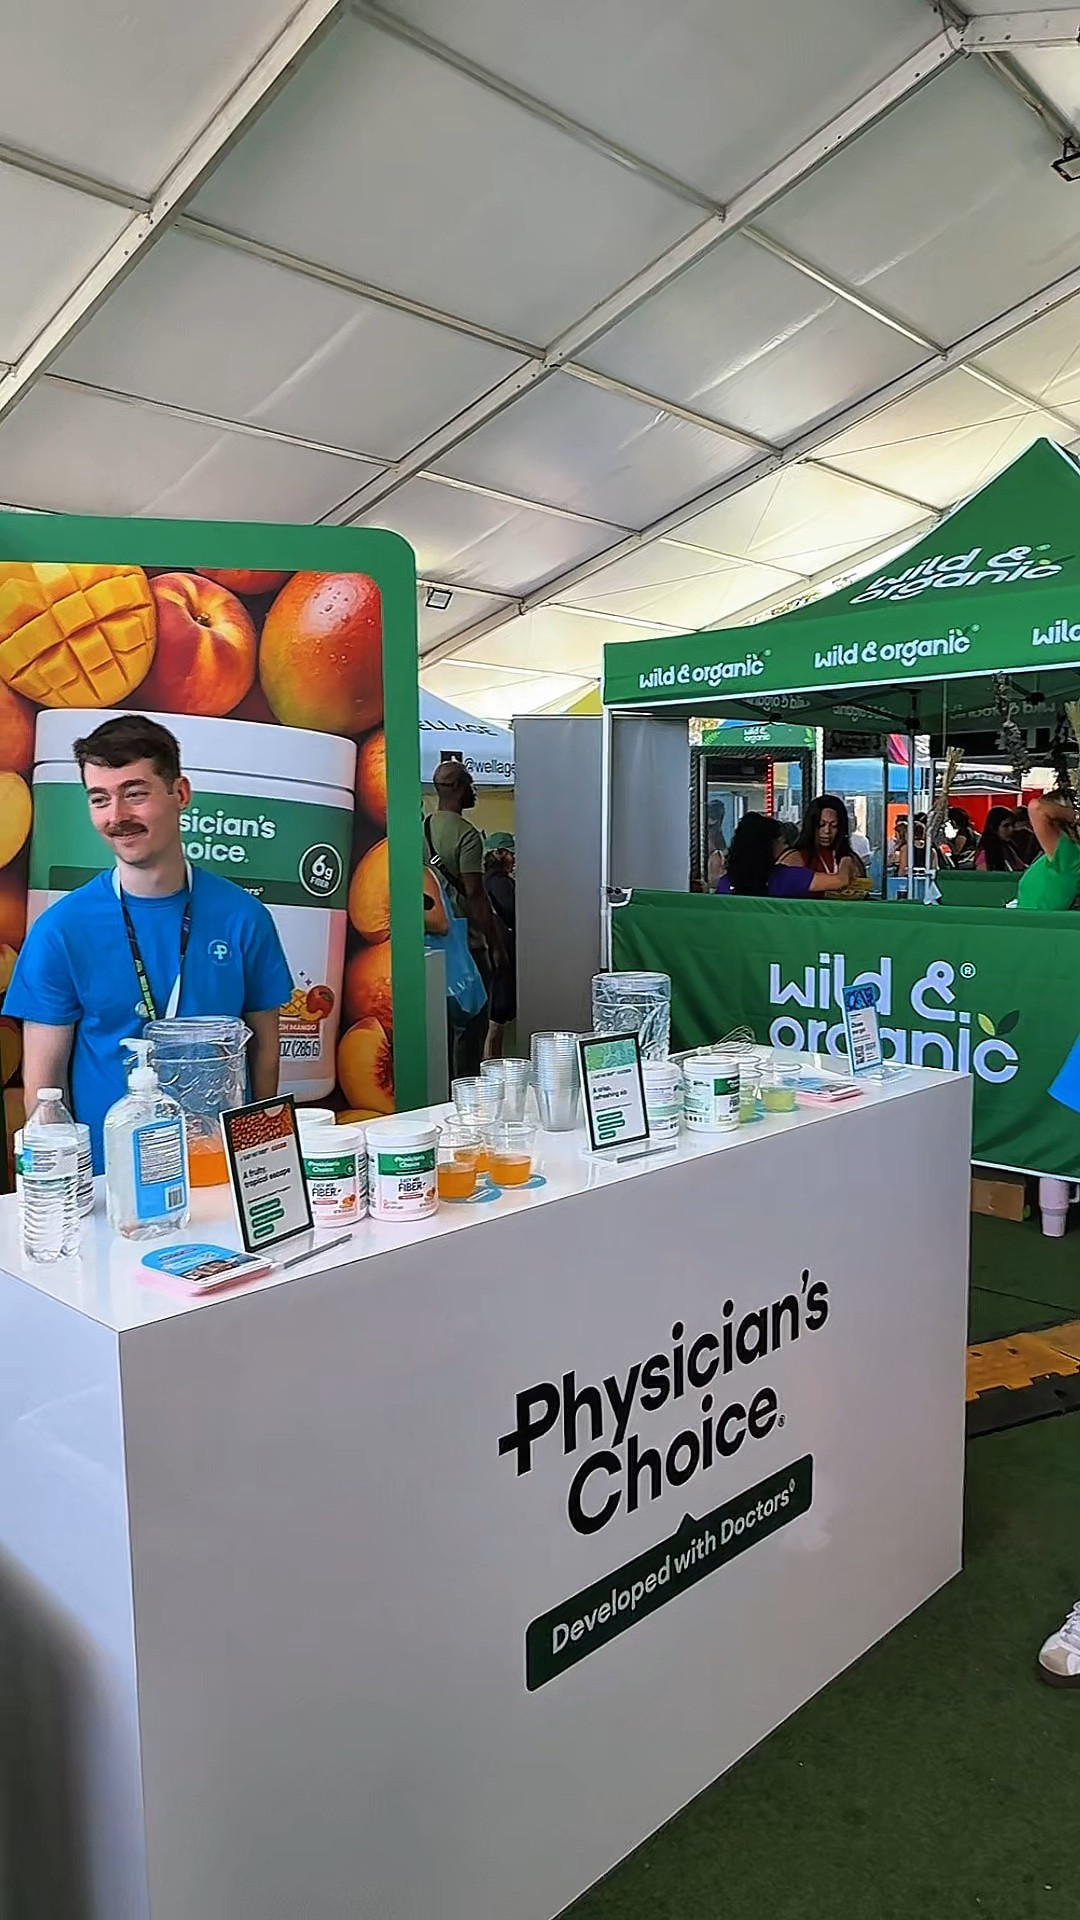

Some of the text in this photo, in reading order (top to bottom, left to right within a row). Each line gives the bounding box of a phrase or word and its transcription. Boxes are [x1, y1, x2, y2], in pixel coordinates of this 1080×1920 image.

[849, 560, 1063, 605] organic
[865, 546, 1033, 591] wild &
[814, 628, 970, 668] wild & organic
[639, 653, 764, 688] wild & organic
[419, 720, 498, 736] ELLAGE
[179, 807, 277, 839] sician's
[311, 854, 334, 881] 6g
[769, 953, 892, 1016] wild
[910, 960, 956, 1022] &
[498, 1268, 829, 1477] Physician's
[552, 1555, 671, 1655] Developed
[674, 1531, 717, 1574] with
